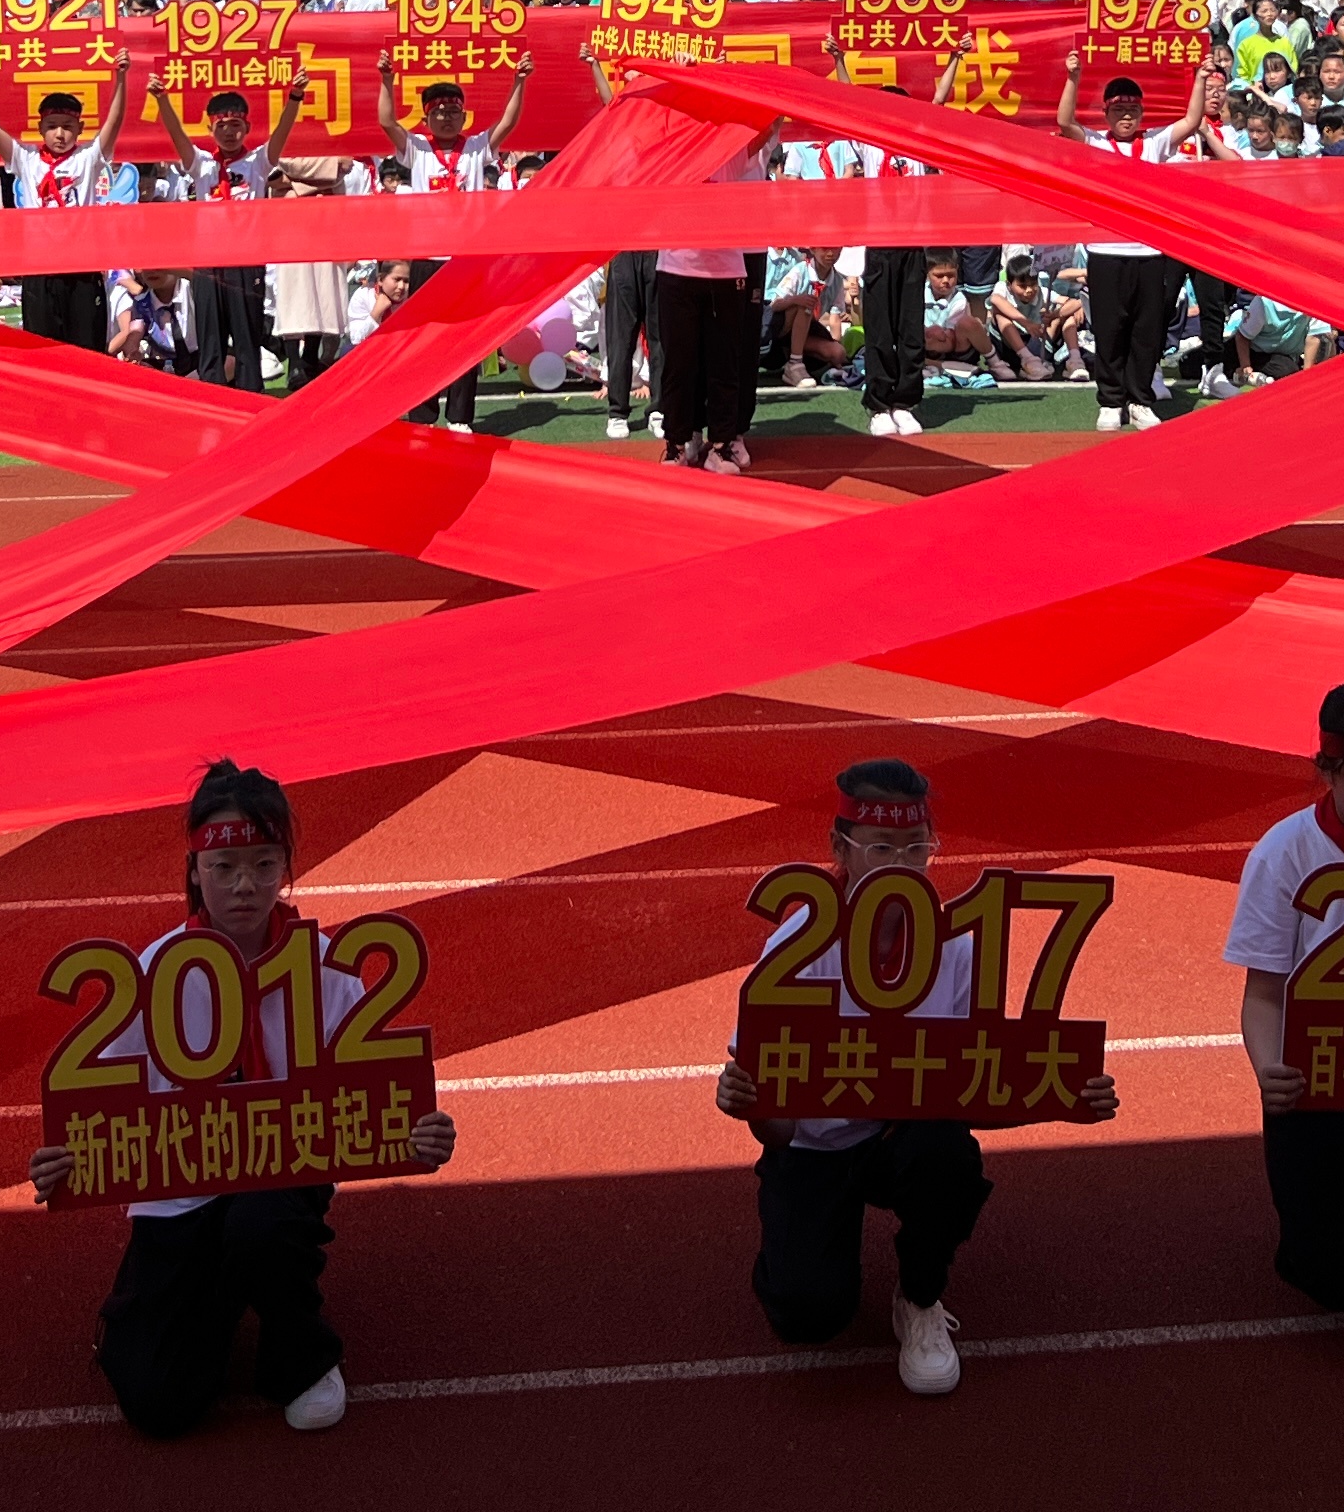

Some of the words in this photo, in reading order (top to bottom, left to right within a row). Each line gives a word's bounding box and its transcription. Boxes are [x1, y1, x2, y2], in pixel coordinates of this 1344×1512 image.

[392, 41, 519, 71] 中共七大
[839, 19, 959, 49] 中共八大
[1082, 36, 1203, 65] 十一届三中全会
[163, 59, 294, 90] 井冈山会师
[747, 871, 1107, 1010] 2017
[48, 921, 423, 1091] 2012
[758, 1026, 1079, 1109] 中共十九大
[65, 1081, 416, 1196] 新时代的历史起点
